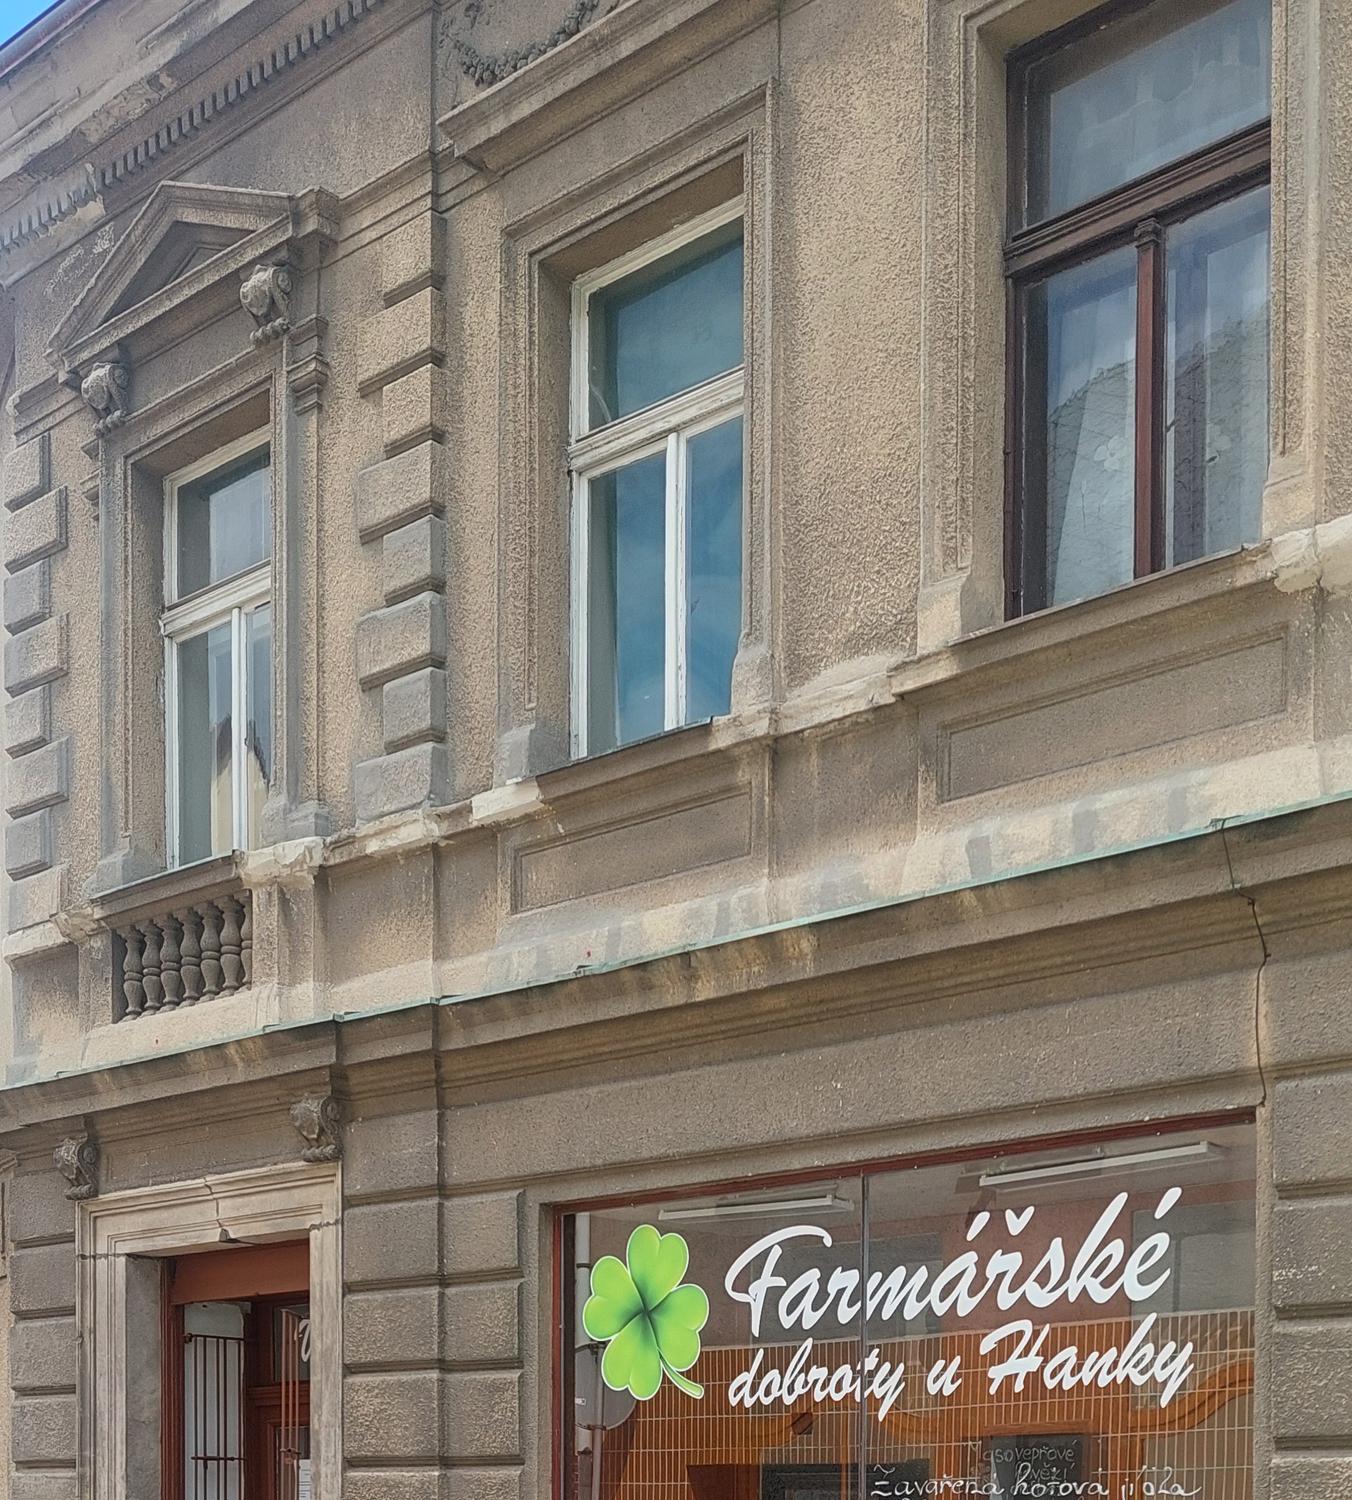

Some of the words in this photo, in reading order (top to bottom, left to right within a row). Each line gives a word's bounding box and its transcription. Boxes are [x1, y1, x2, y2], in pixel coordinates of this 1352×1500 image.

[725, 1187, 1182, 1338] Farmářské
[727, 1337, 905, 1422] dobroty
[926, 1353, 962, 1397] u
[979, 1312, 1195, 1409] Hanky
